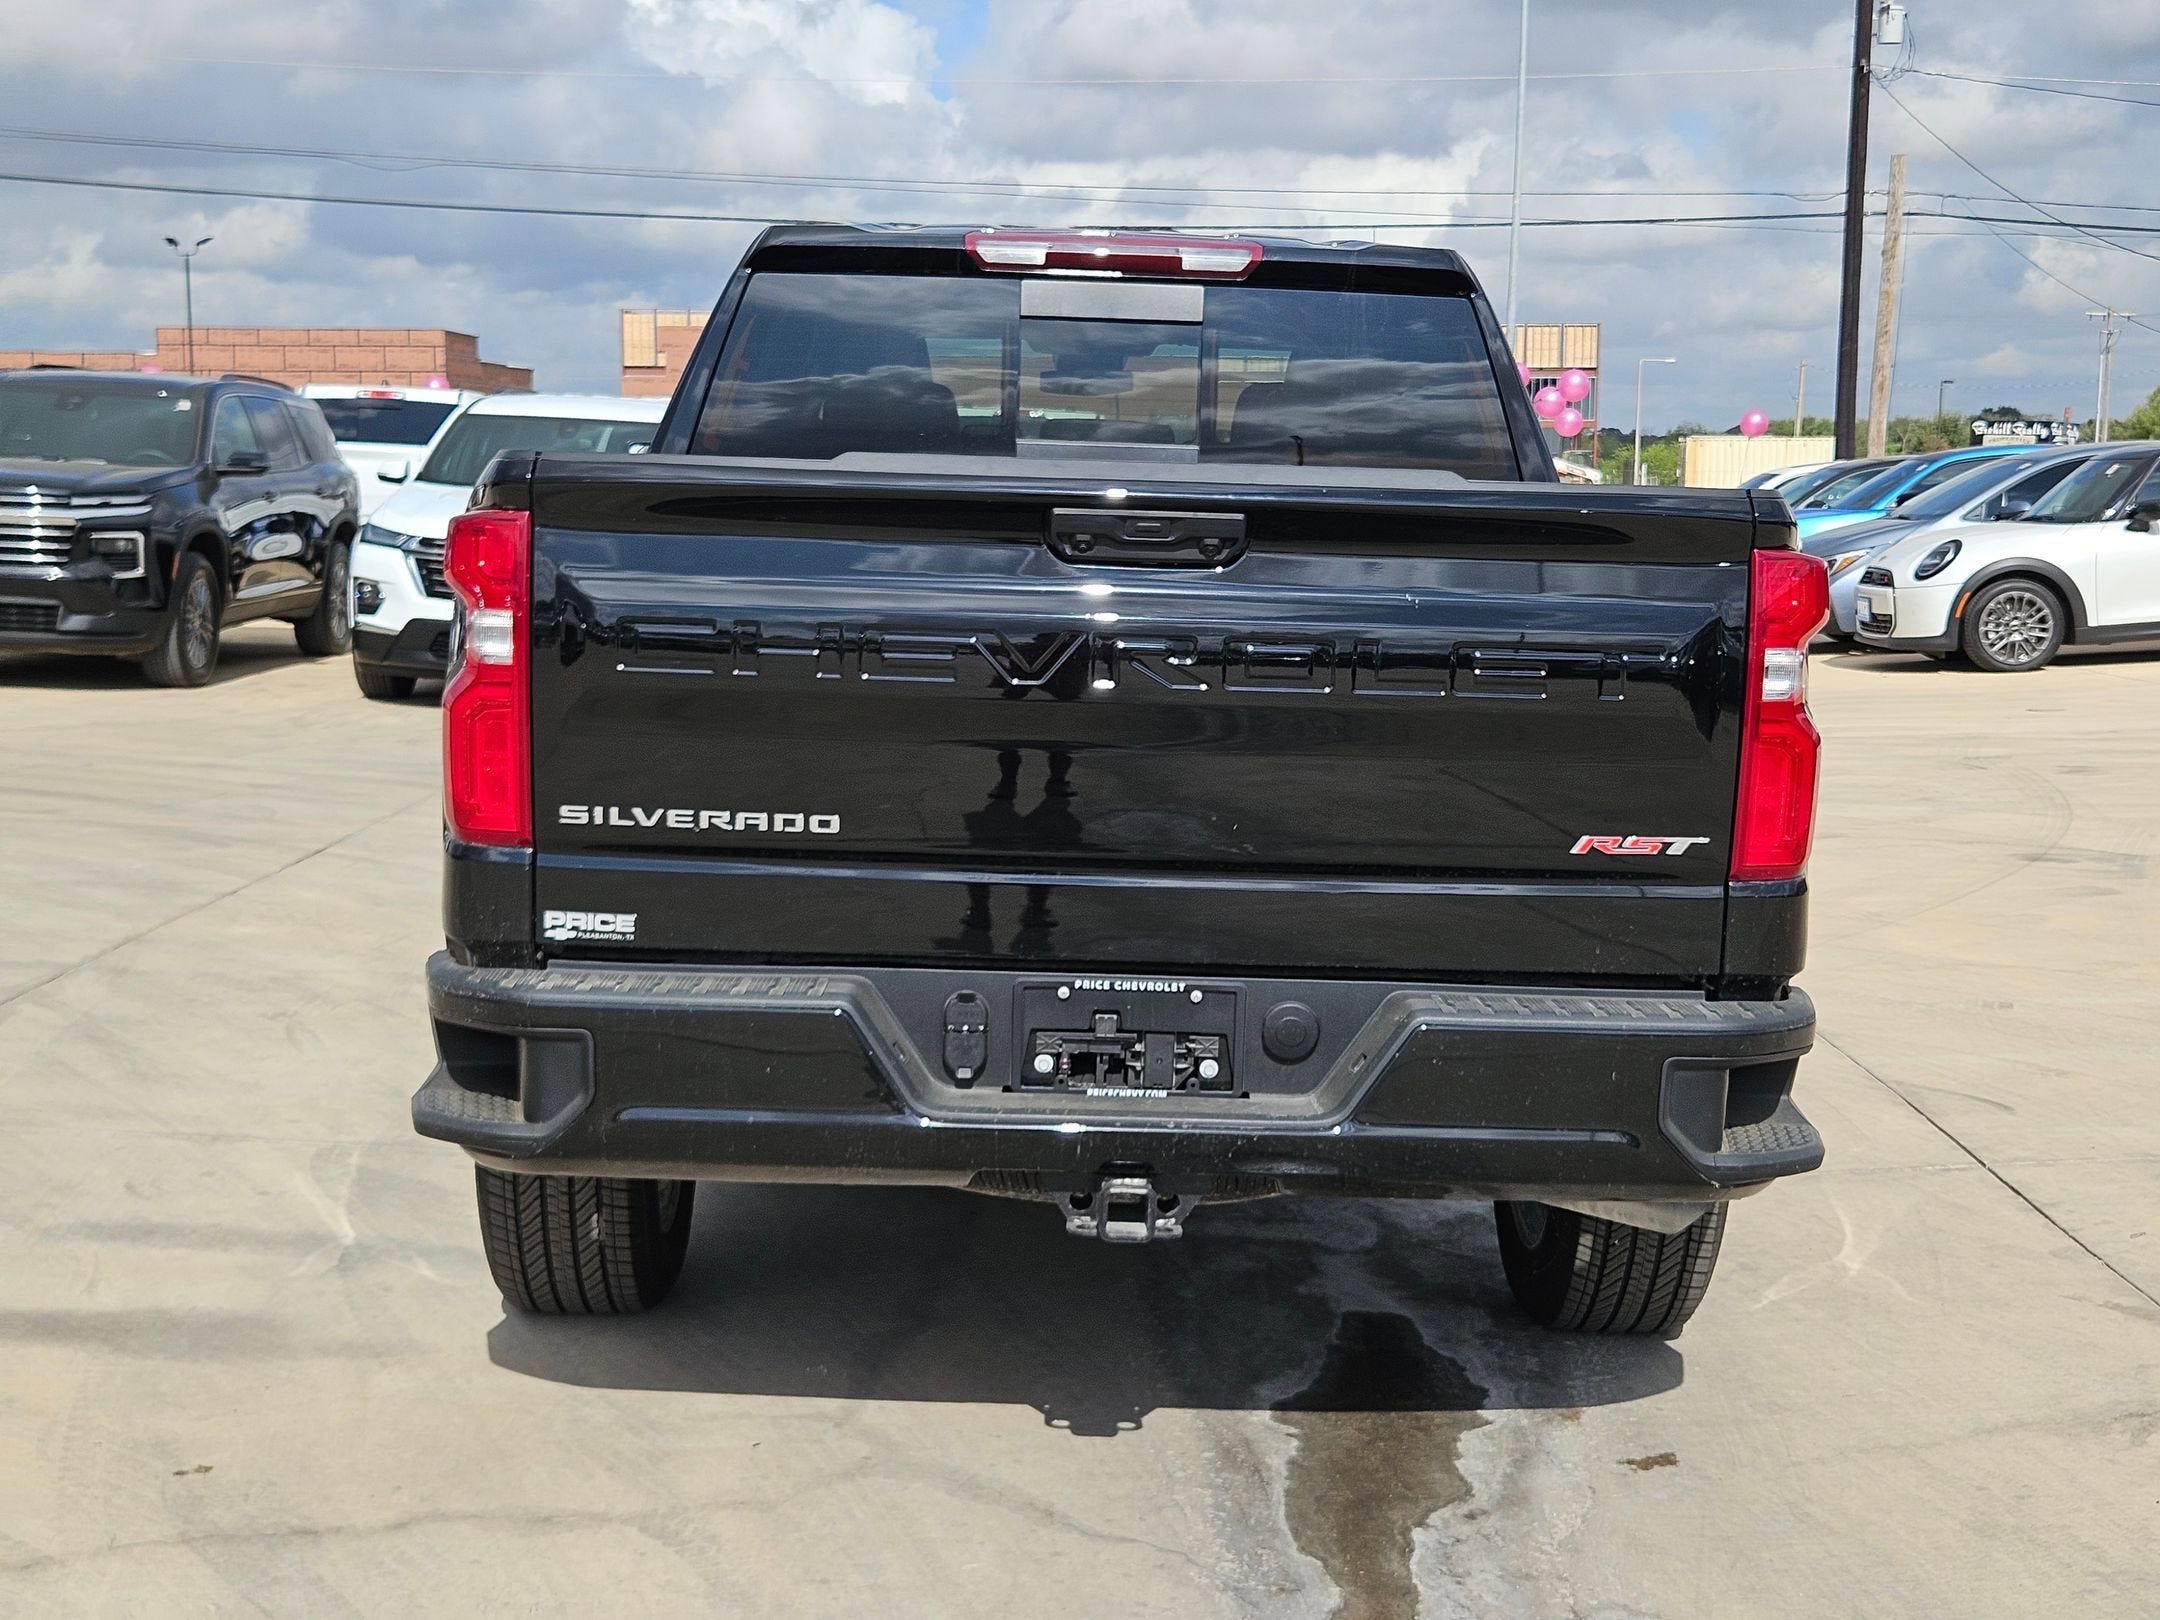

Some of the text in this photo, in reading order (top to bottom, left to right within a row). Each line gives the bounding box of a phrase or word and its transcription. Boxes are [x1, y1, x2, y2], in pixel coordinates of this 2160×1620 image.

[615, 614, 1668, 702] CHEVROLET
[558, 803, 842, 835] SILVERADO
[1569, 834, 1711, 856] RST
[543, 910, 637, 933] PRICE
[1074, 979, 1186, 992] PRICE CHEVROLET
